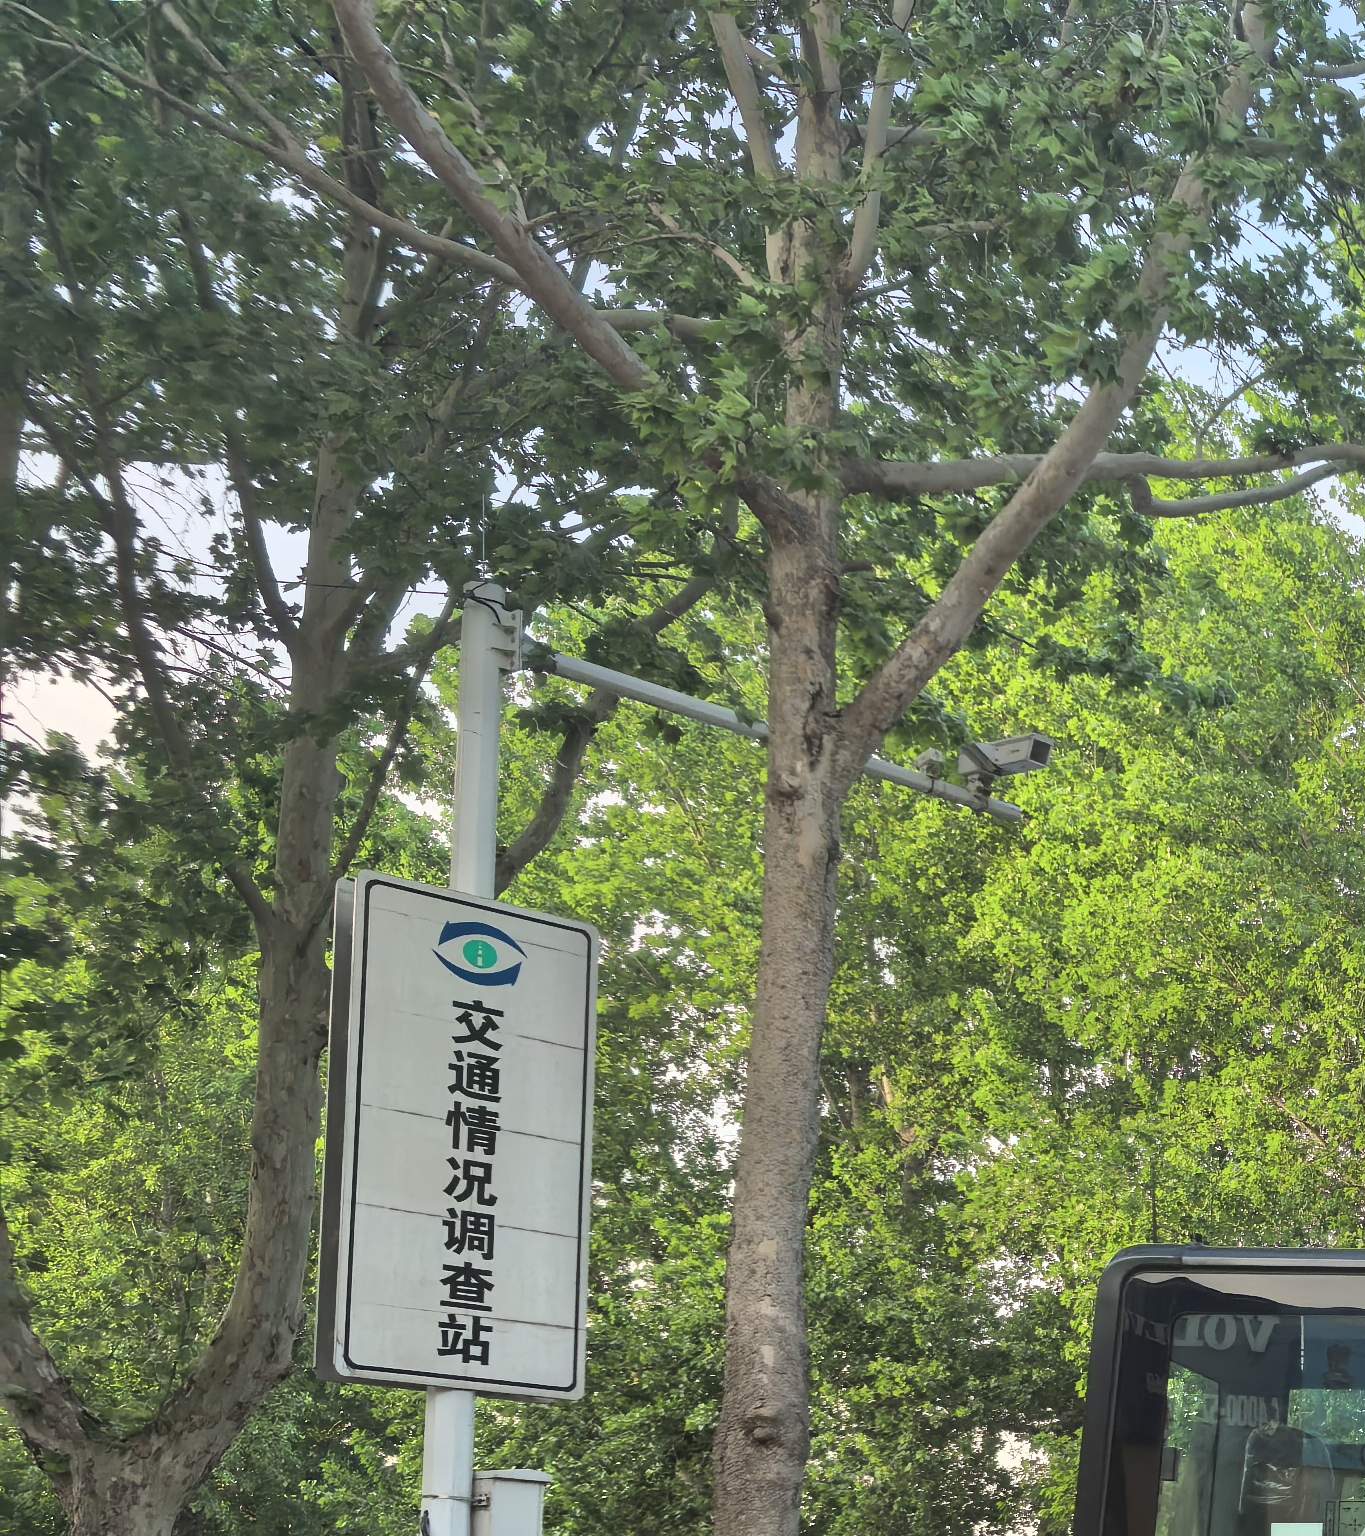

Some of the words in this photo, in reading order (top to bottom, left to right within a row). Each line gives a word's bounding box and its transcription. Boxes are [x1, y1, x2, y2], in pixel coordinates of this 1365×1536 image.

[436, 1000, 505, 1366] 交通情况调查站
